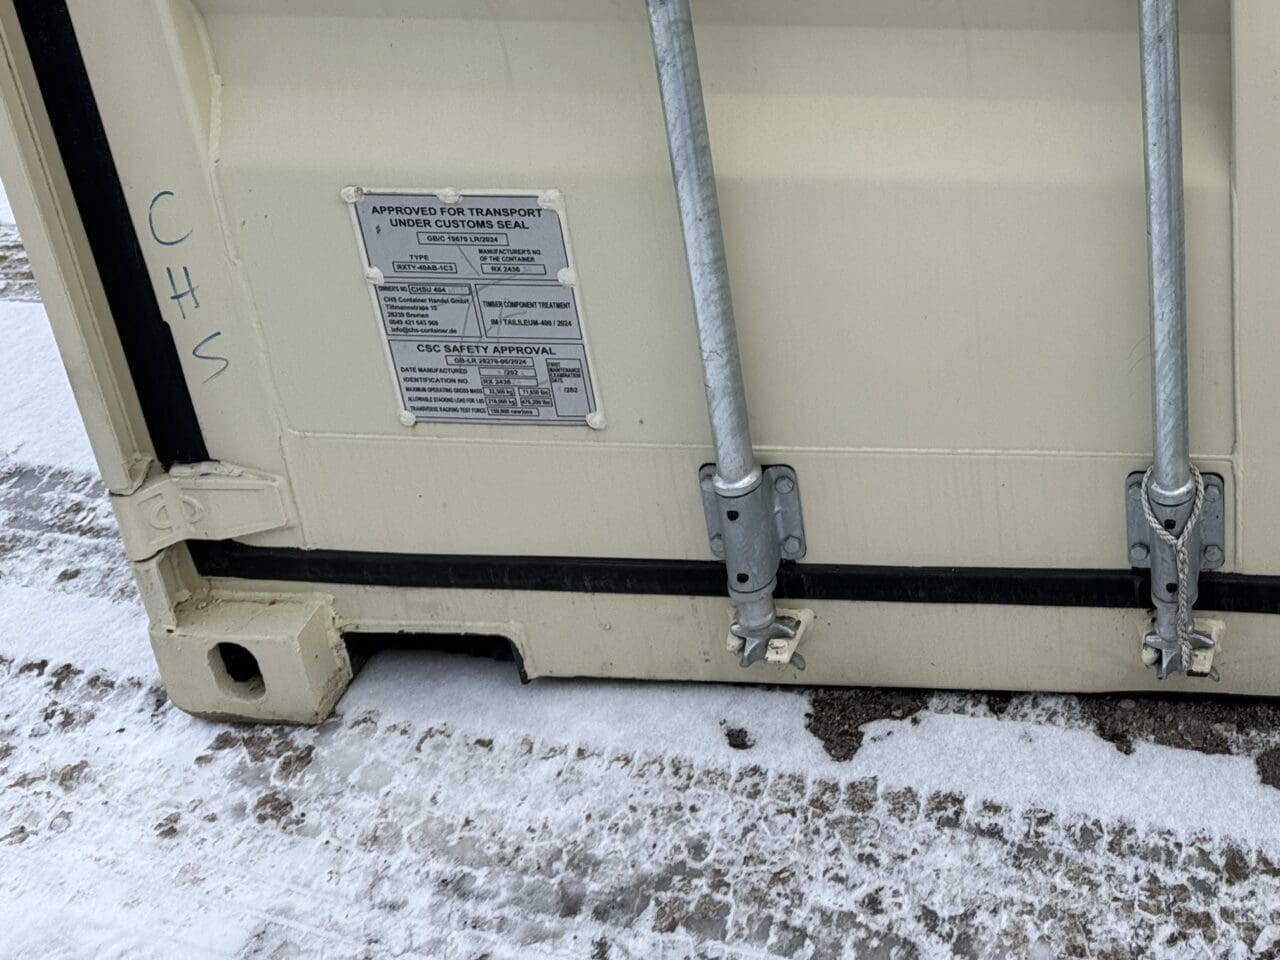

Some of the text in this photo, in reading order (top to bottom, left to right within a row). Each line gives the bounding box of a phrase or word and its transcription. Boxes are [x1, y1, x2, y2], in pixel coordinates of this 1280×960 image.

[372, 206, 542, 218] APPROVED FOR TRANSPORT
[390, 219, 529, 230] UNDER CUSTOMS SEAL
[417, 344, 556, 355] CSC SAFETY APPROVAL
